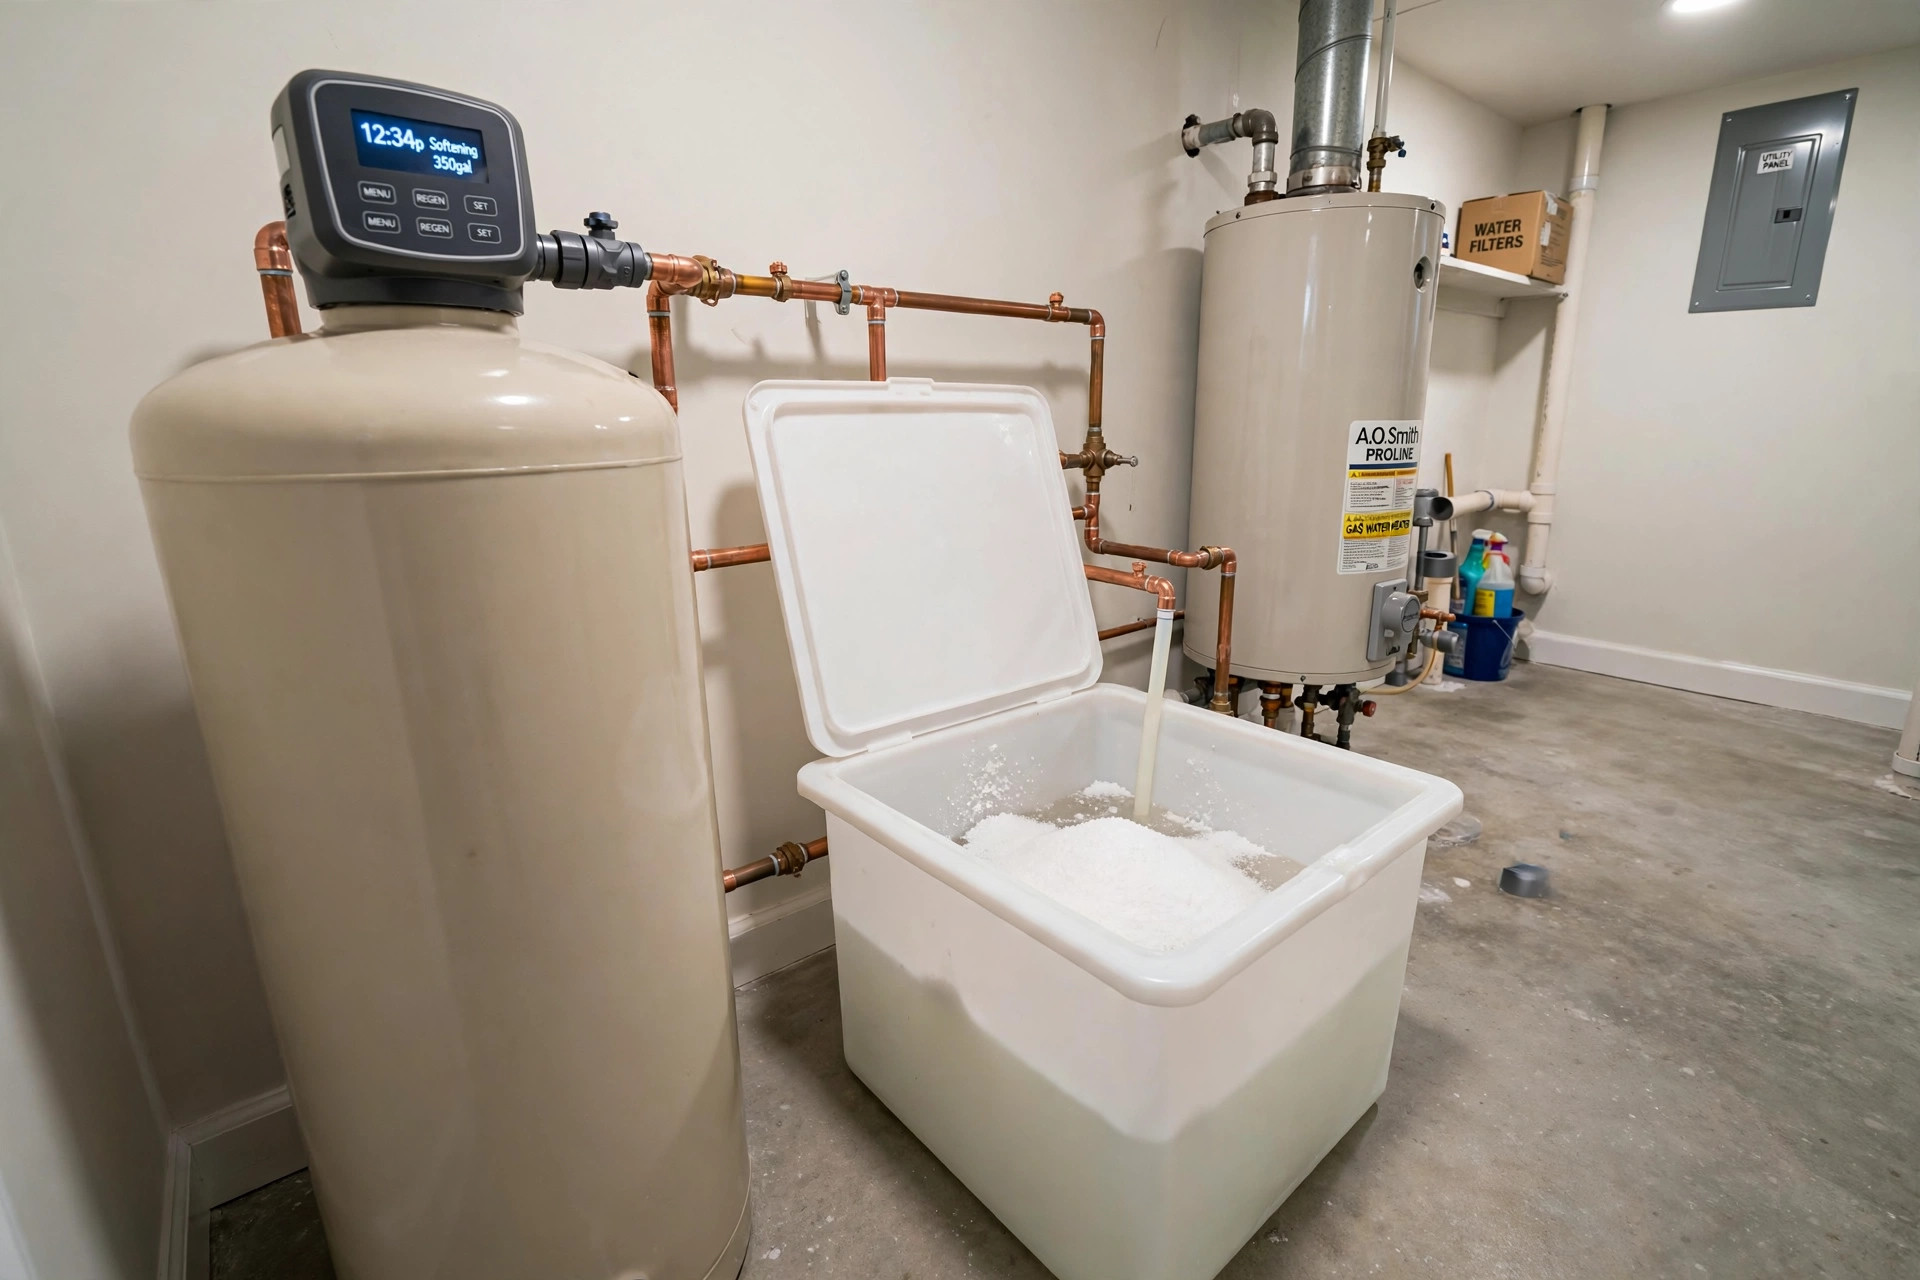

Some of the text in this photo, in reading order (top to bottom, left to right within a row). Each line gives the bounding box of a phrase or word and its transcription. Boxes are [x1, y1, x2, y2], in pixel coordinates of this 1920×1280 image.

[360, 122, 478, 159] 12:34p Softening
[1762, 151, 1793, 161] UTILITY
[433, 155, 473, 175] 350gal
[1762, 160, 1789, 169] PANEL
[363, 187, 391, 198] MENU
[416, 194, 446, 206] REGEN
[473, 201, 488, 211] SET
[367, 217, 396, 229] MENU
[420, 223, 449, 234] REGEN
[1475, 219, 1521, 236] WATER
[476, 228, 492, 238] SET
[1469, 235, 1523, 253] FILTERS
[1366, 447, 1414, 462] PROLINE
[1346, 522, 1364, 535] GAS
